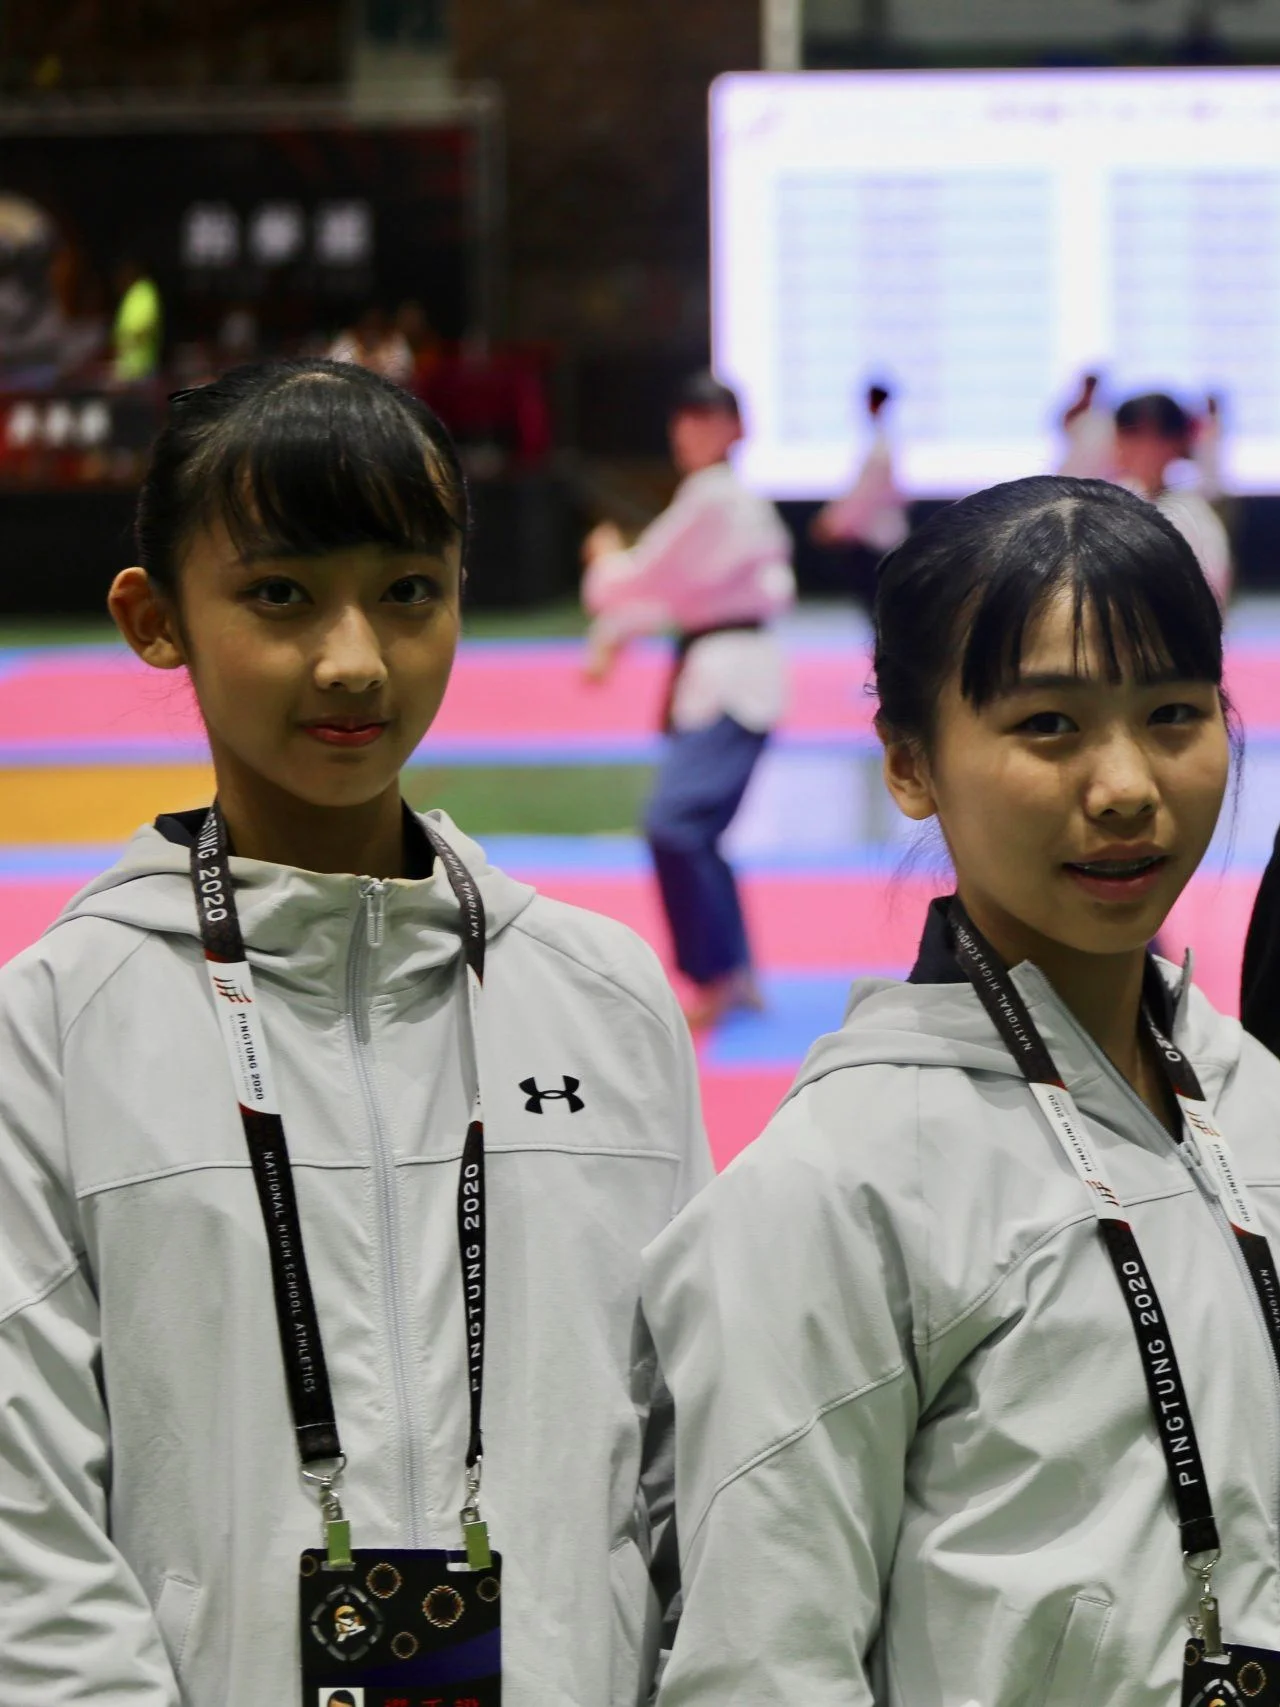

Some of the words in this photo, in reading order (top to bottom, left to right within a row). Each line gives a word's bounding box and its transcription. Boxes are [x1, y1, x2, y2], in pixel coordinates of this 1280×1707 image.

[199, 866, 228, 922] 2020
[462, 881, 481, 938] NATIONAL
[978, 962, 1001, 991] HIGH
[998, 993, 1033, 1052] NATIONAL
[237, 1013, 258, 1069] PINGTUNG
[251, 1073, 264, 1100] 2020
[1047, 1094, 1065, 1118] 2020
[1062, 1121, 1093, 1172] PINGTUNG
[464, 1164, 480, 1230] 2020
[1213, 1144, 1238, 1195] PINGTUNG
[1236, 1199, 1250, 1222] 2020
[262, 1151, 282, 1217] NATIONAL
[278, 1224, 291, 1260] HIGH
[285, 1264, 301, 1316] SCHOOL
[294, 1323, 316, 1393] ATHLETICS
[1122, 1261, 1158, 1325] 2020
[1260, 1269, 1280, 1331] NATIONAL
[466, 1244, 481, 1392] PINGTUNG
[1148, 1339, 1198, 1486] PINGTUNG
